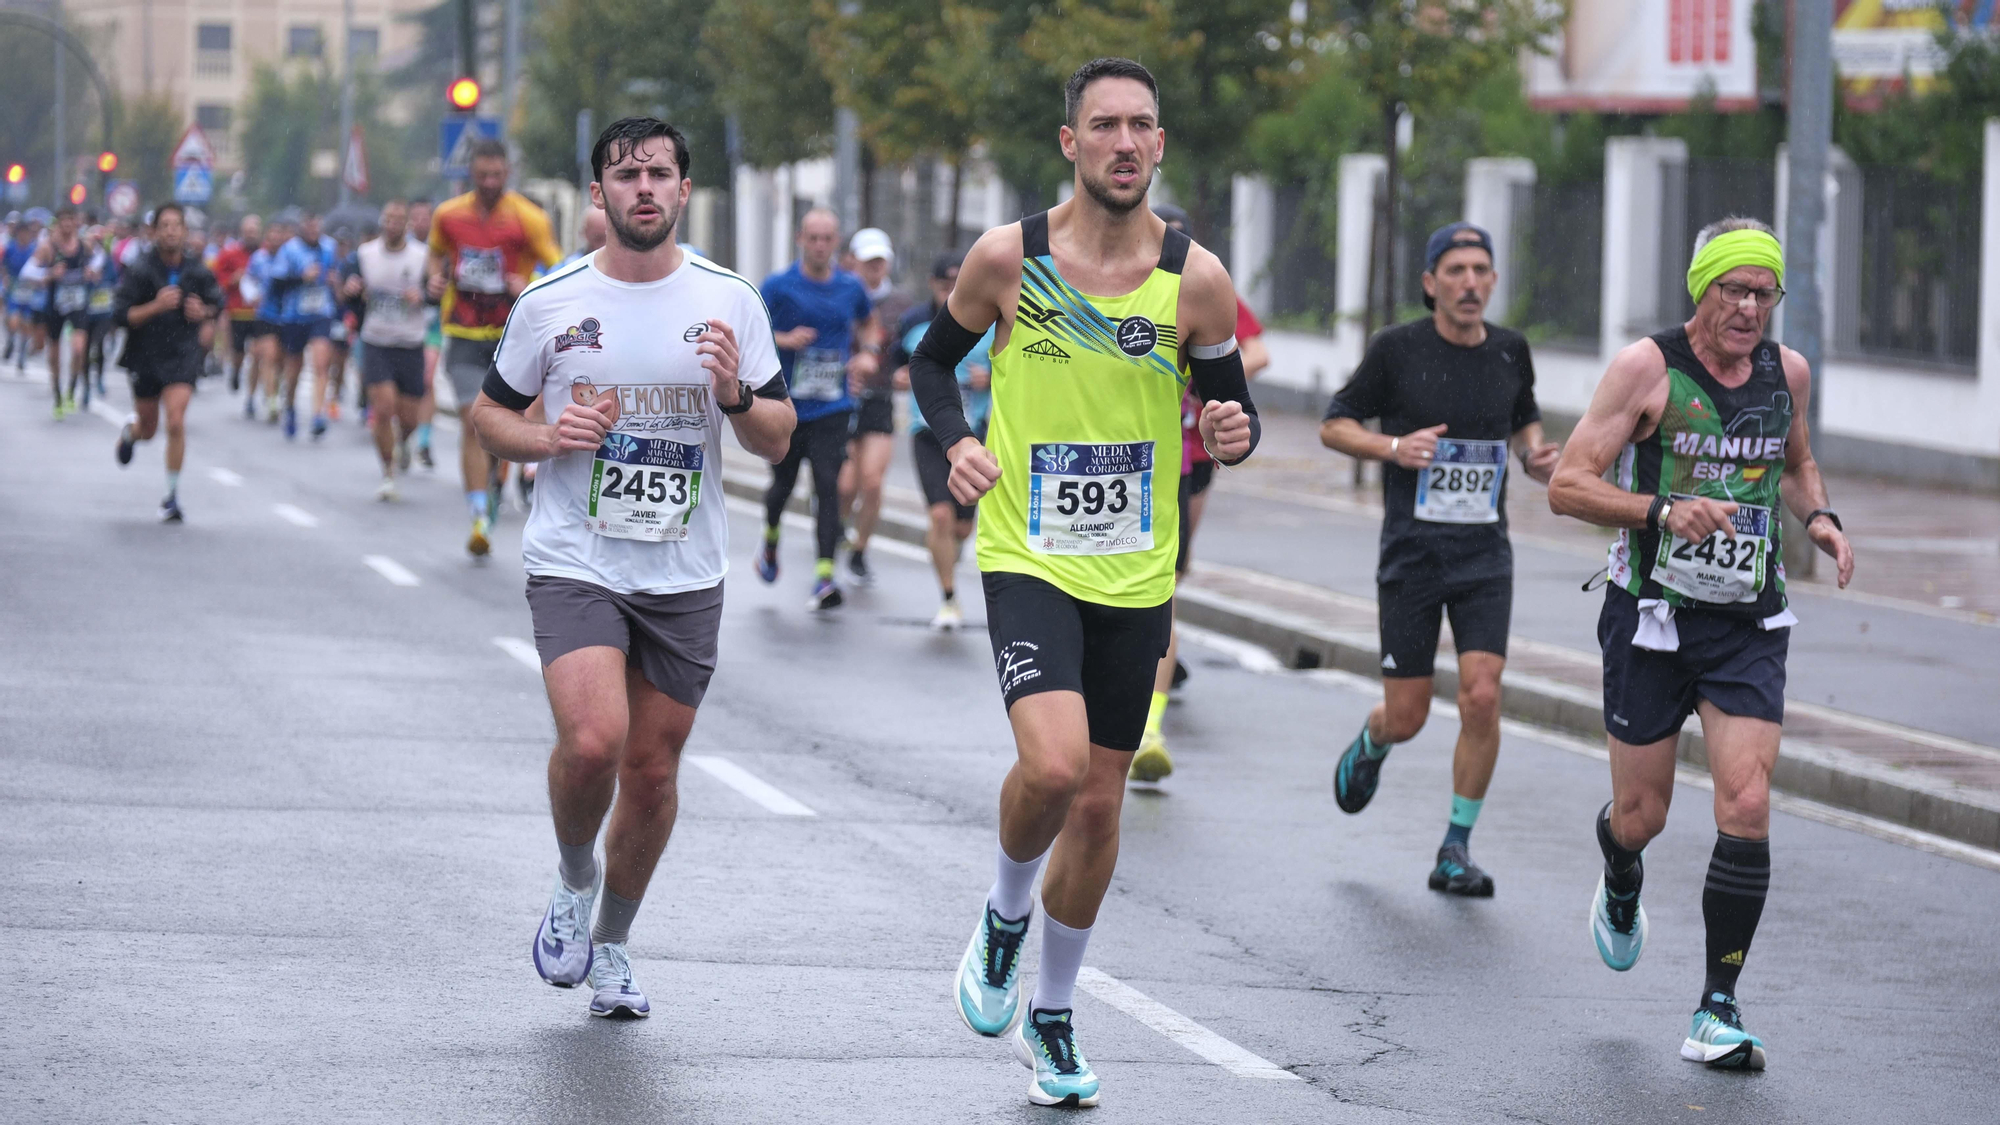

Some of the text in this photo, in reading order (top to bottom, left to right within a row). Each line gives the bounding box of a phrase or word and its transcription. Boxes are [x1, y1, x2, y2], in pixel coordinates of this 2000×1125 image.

[556, 332, 597, 349] MAGIC
[649, 440, 684, 454] MEDIA
[1091, 445, 1132, 457] MEDIA
[647, 449, 683, 460] MARATÓN
[1091, 455, 1132, 465] MARATÓN
[1085, 463, 1135, 474] CÓRDOBA
[1692, 461, 1736, 480] ESP
[601, 466, 687, 505] 2453
[1430, 467, 1494, 492] 2892
[591, 480, 600, 503] CAJÓN
[1056, 478, 1129, 516] 593
[631, 510, 657, 519] JAVIER
[1070, 522, 1115, 532] ALEJANDRO
[1106, 536, 1137, 547] IMDECO
[1672, 534, 1756, 572] 2432
[1696, 572, 1726, 584] MANUEL
